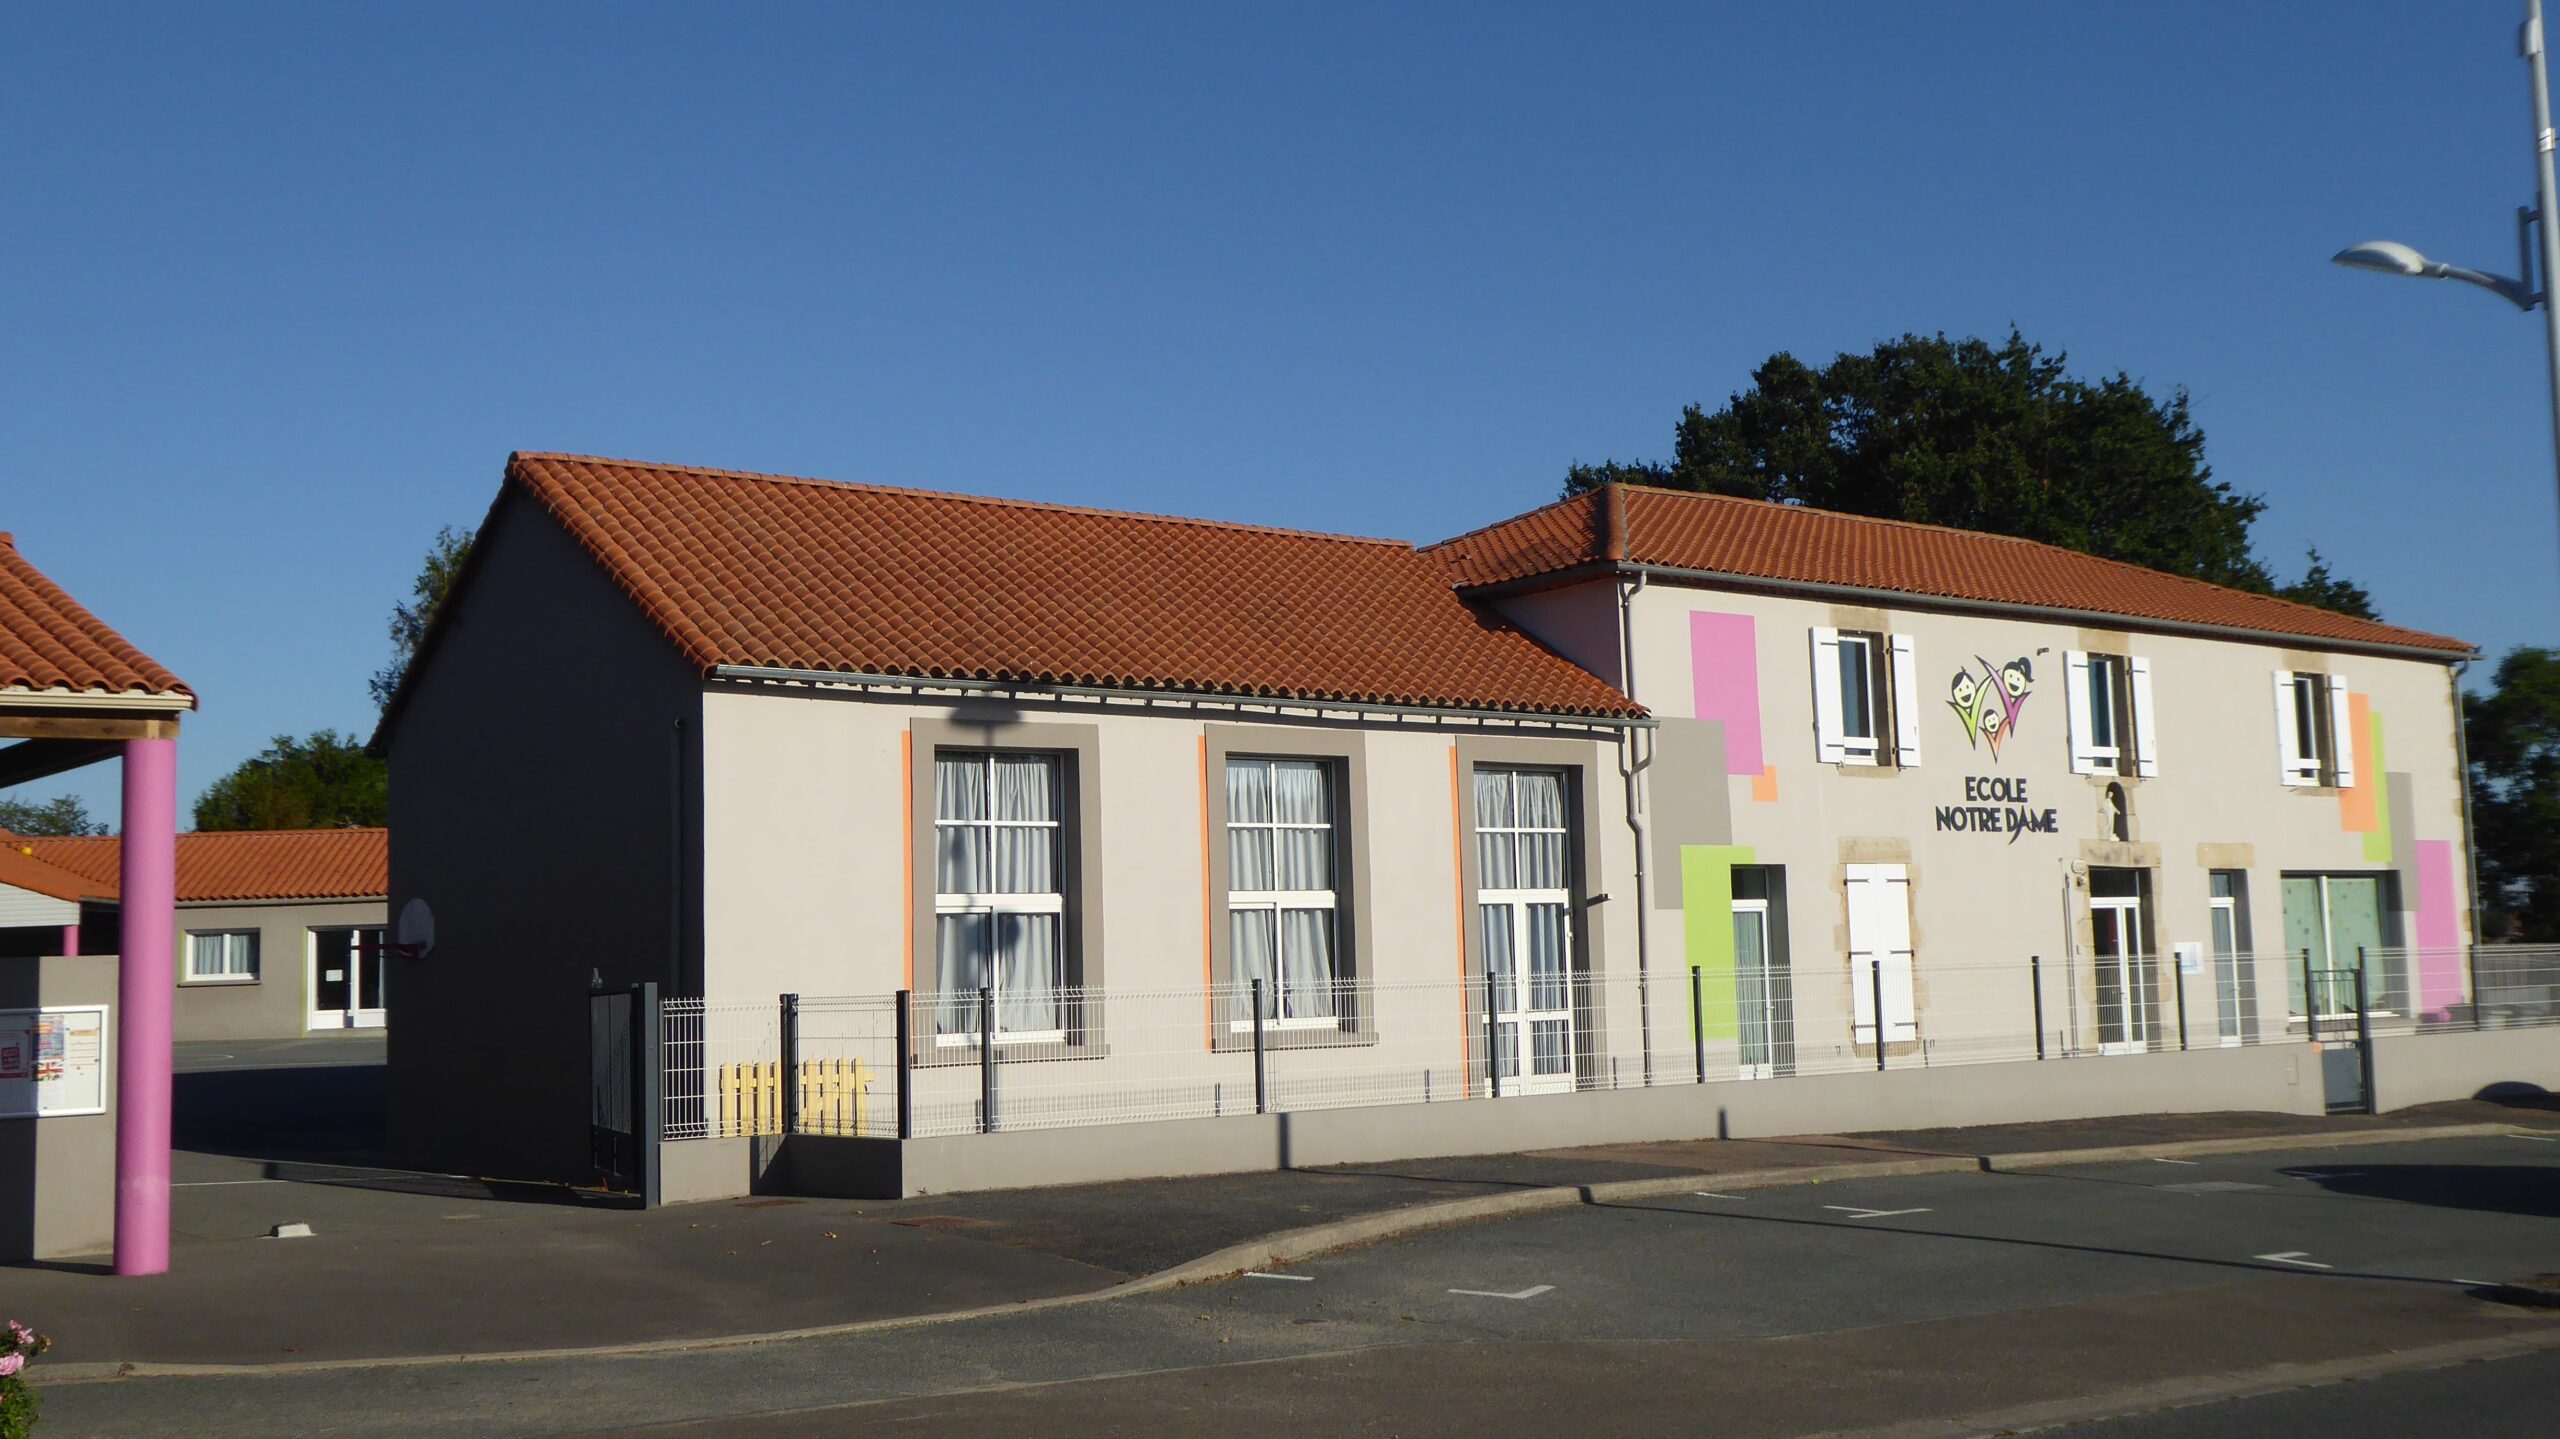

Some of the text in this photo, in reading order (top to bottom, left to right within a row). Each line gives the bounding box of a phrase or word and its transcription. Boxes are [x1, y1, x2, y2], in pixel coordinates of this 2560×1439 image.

[1965, 776, 2028, 803] ECOLE
[1935, 805, 2059, 845] NOTRE DAME
